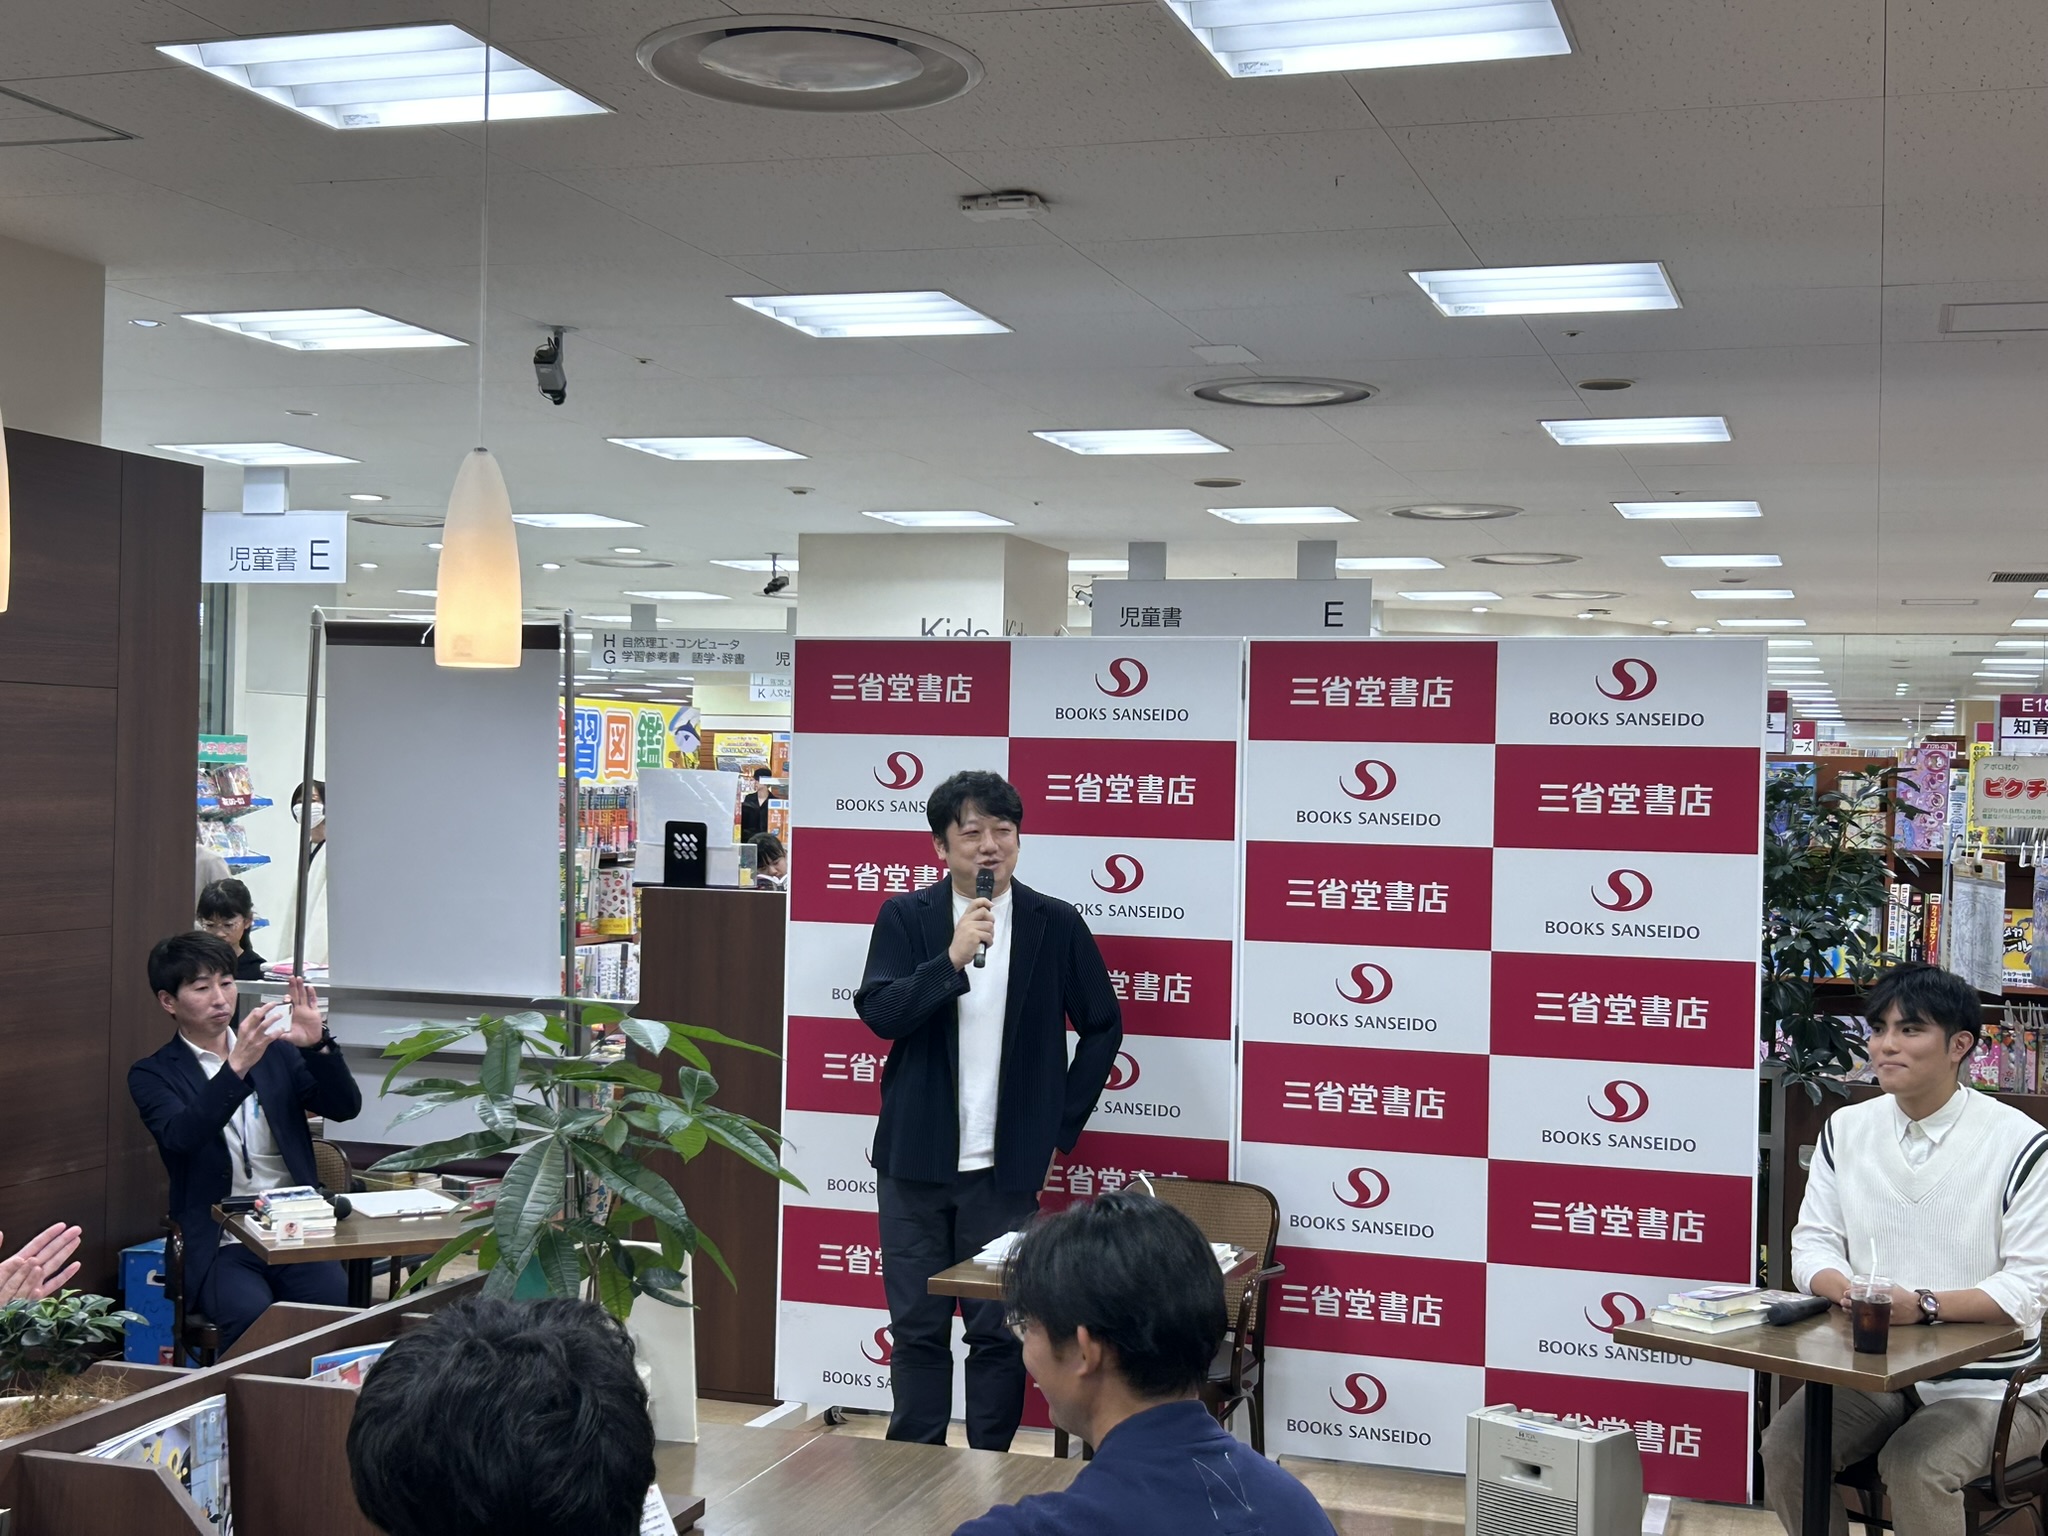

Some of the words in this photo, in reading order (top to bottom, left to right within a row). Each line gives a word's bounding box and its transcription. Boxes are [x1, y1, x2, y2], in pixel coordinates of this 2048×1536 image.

[229, 547, 297, 571] 児童書
[310, 540, 330, 570] E
[1120, 606, 1182, 628] 児童書
[1324, 601, 1344, 627] E
[603, 633, 616, 648] H
[603, 649, 616, 665] G
[775, 651, 791, 667] 児
[757, 688, 766, 698] K
[830, 672, 973, 703] 三省堂書店
[1290, 676, 1454, 708] 三省堂書店
[1055, 707, 1107, 721] BOOKS
[1112, 707, 1189, 722] SANSEIDO
[1549, 711, 1609, 726] BOOKS
[1615, 711, 1705, 727] SANSEIDO
[558, 708, 664, 780] 習図鑑
[1045, 773, 1197, 805] 三省堂書店
[1537, 781, 1714, 816] 三省堂書店
[836, 799, 885, 812] BOOKS
[889, 800, 926, 814] SANS
[1296, 810, 1352, 824] BOOKS
[1358, 811, 1442, 827] SANSEIDO
[826, 862, 950, 893] 三省堂書
[1285, 877, 1450, 914] 三省堂書店
[1074, 903, 1103, 917] OKS
[1108, 904, 1185, 920] SANSEIDO
[1544, 921, 1605, 936] BOOKS
[1611, 923, 1701, 940] SANSEIDO
[1107, 969, 1193, 1004] 堂書店
[1292, 1012, 1349, 1027] BOOKS
[1354, 1015, 1438, 1032] SANSEIDO
[1534, 991, 1710, 1030] 三省堂書店
[1104, 1101, 1181, 1118] SANSEIDO
[1282, 1081, 1446, 1120] 三省堂書店
[1541, 1129, 1602, 1146] BOOKS
[1607, 1133, 1697, 1153] SANSEIDO
[827, 1178, 876, 1194] BOOKS
[1044, 1164, 1189, 1196] 三省堂
[1289, 1215, 1346, 1231] BOOKS
[1351, 1219, 1435, 1239] SANSEIDO
[1531, 1201, 1706, 1243] 三省堂書店
[1279, 1284, 1444, 1327] 三省堂書店
[1538, 1339, 1599, 1357] BOOKS
[1604, 1345, 1693, 1366] SANSEIDO
[822, 1370, 872, 1387] BOOKS
[1286, 1418, 1343, 1436] BOOKS
[1348, 1424, 1432, 1446] SANSEIDO
